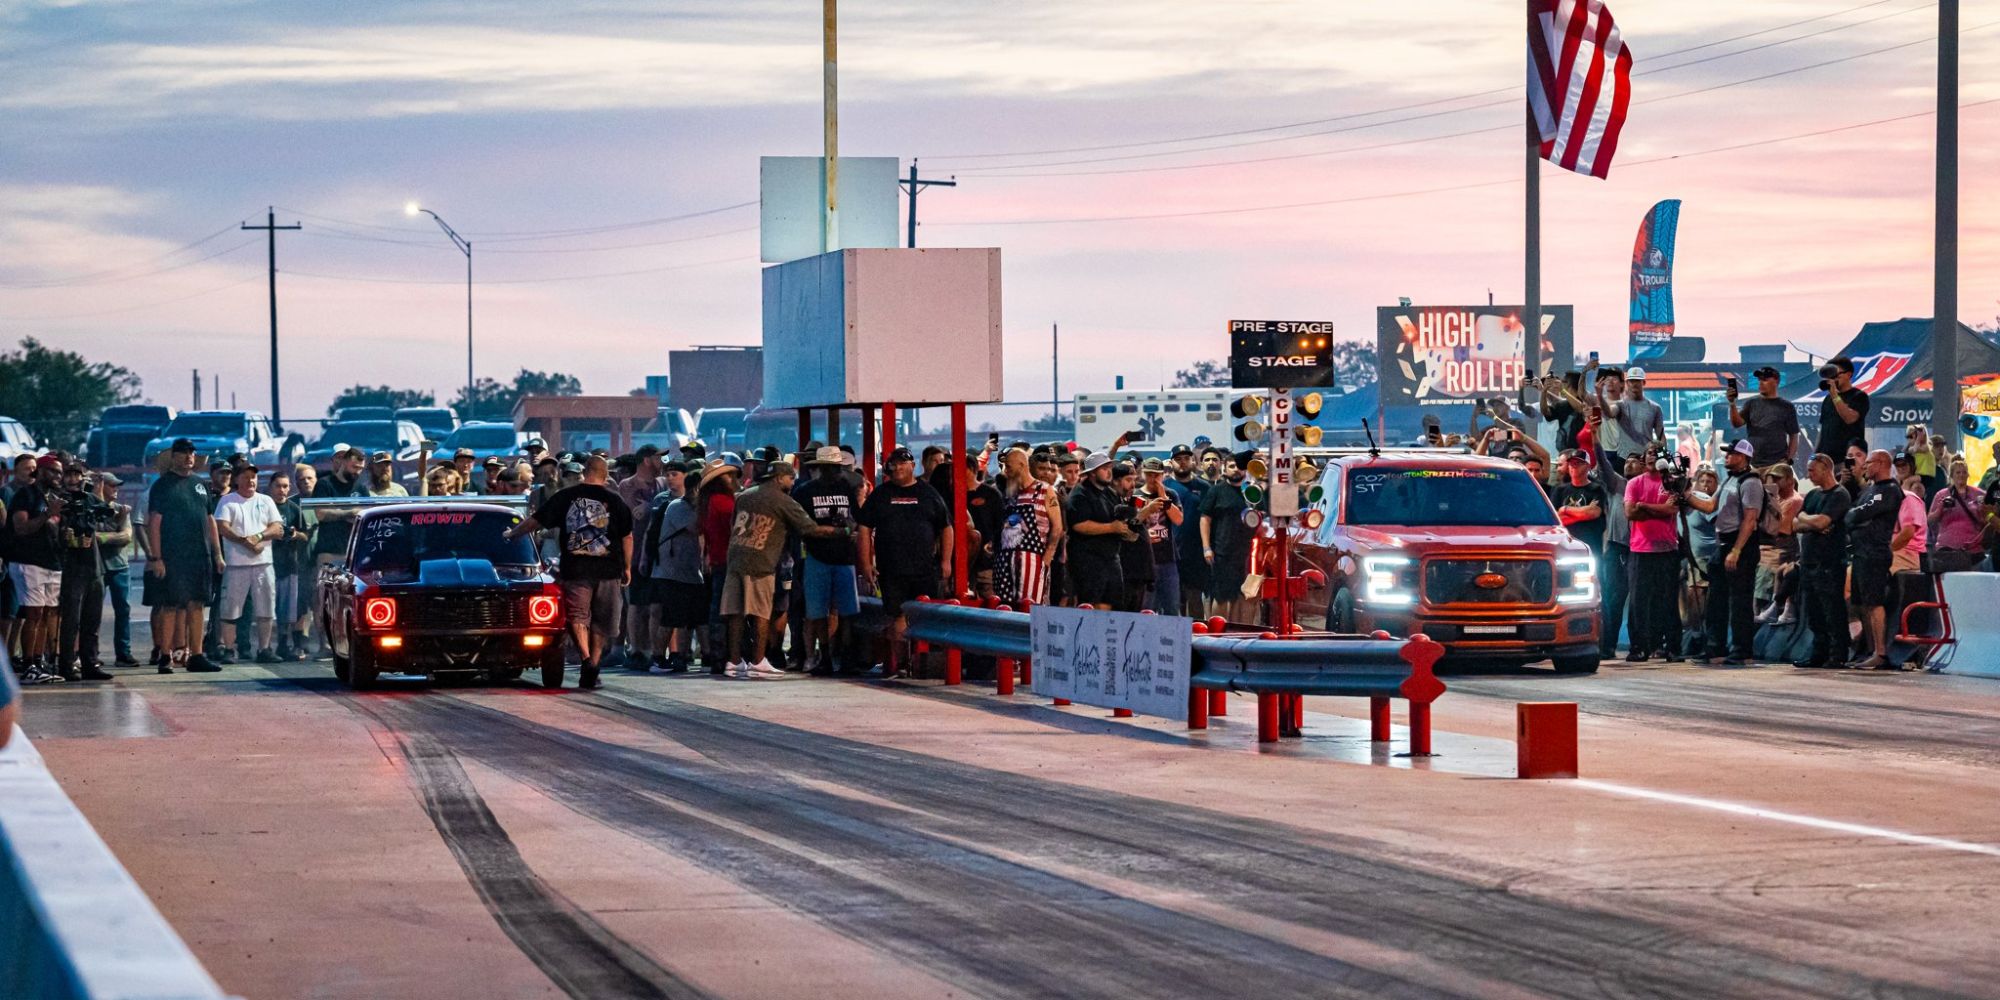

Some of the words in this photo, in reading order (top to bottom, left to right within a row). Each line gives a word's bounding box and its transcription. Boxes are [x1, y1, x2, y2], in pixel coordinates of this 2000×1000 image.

[1639, 273, 1669, 286] TROUBL
[1232, 321, 1332, 333] PRE-STAGE
[1419, 312, 1475, 348] HIGH
[1248, 356, 1317, 367] STAGE
[1795, 404, 1821, 417] ess.
[1880, 406, 1934, 422] Snow
[1354, 474, 1387, 483] 007
[1355, 483, 1383, 493] ST
[410, 513, 476, 526] ROWDY
